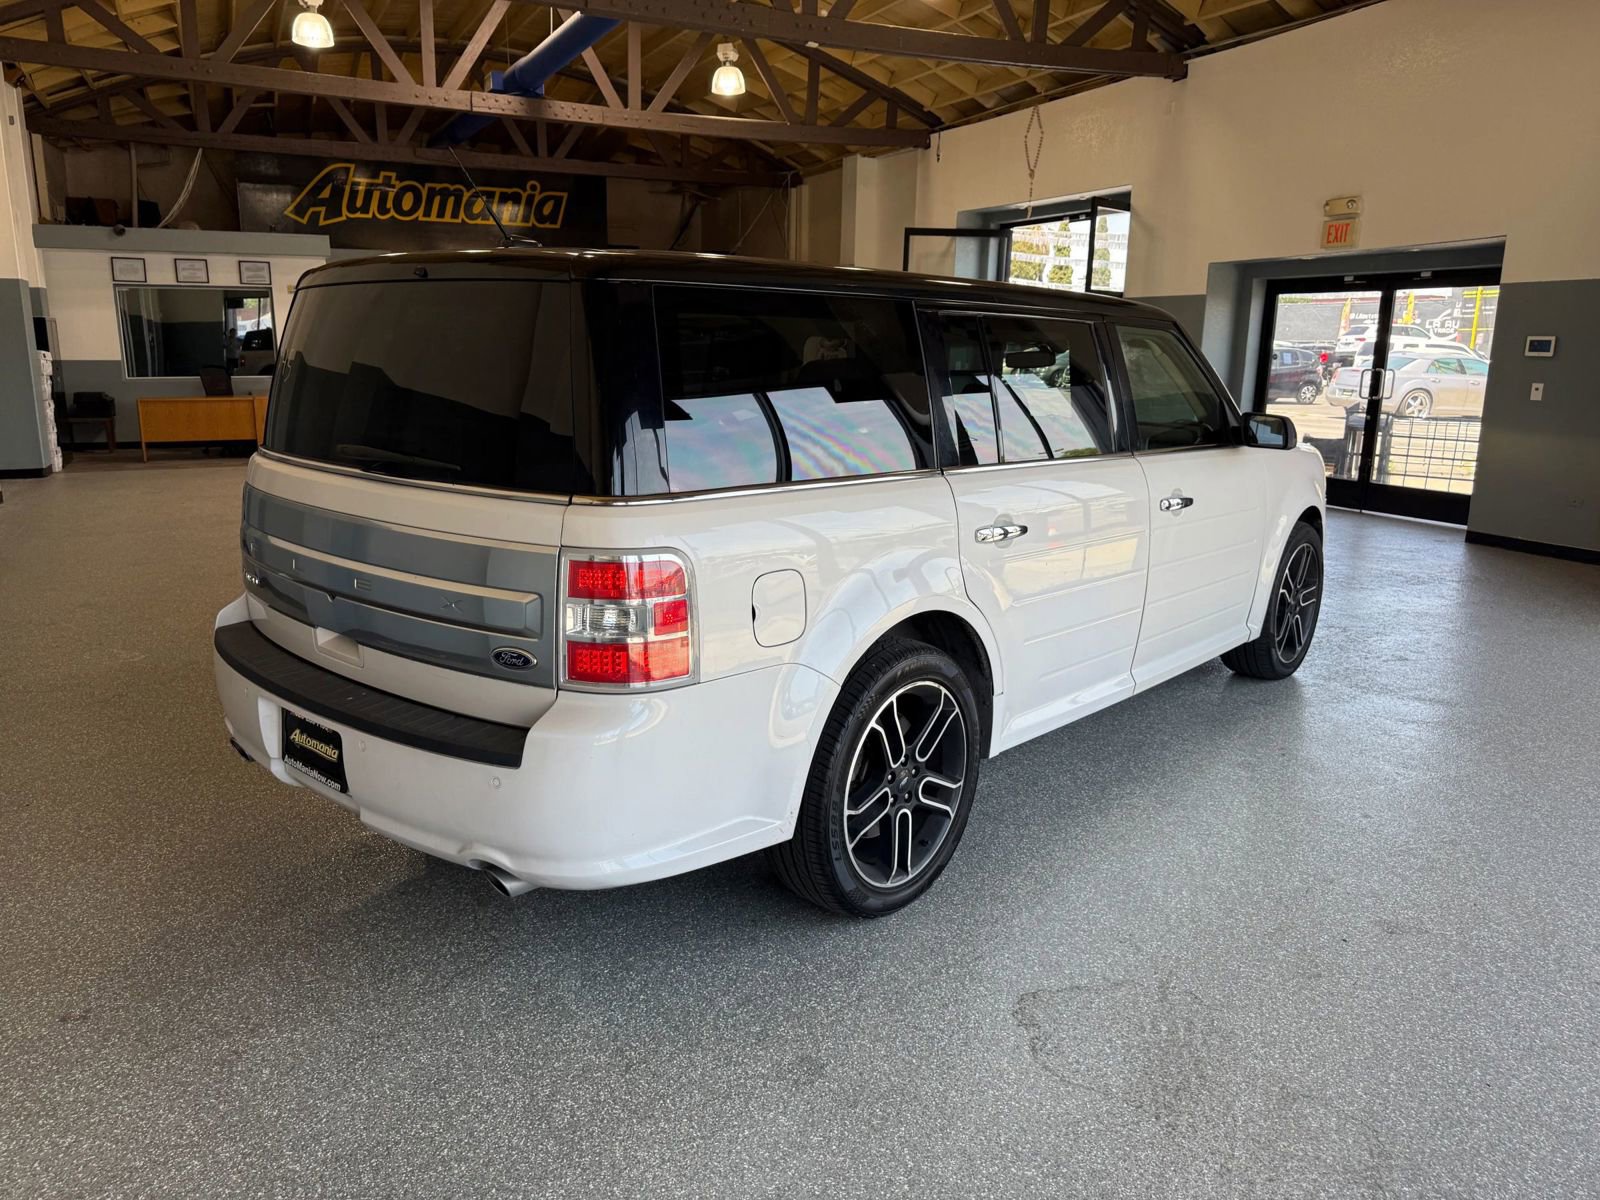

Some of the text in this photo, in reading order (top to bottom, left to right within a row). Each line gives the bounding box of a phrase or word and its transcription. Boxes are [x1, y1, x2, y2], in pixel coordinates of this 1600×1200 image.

[284, 162, 568, 229] Automania
[1327, 223, 1352, 244] EXIT
[500, 651, 525, 666] Ford
[290, 727, 339, 759] Automania
[283, 753, 341, 791] AutoManiaNow.com
